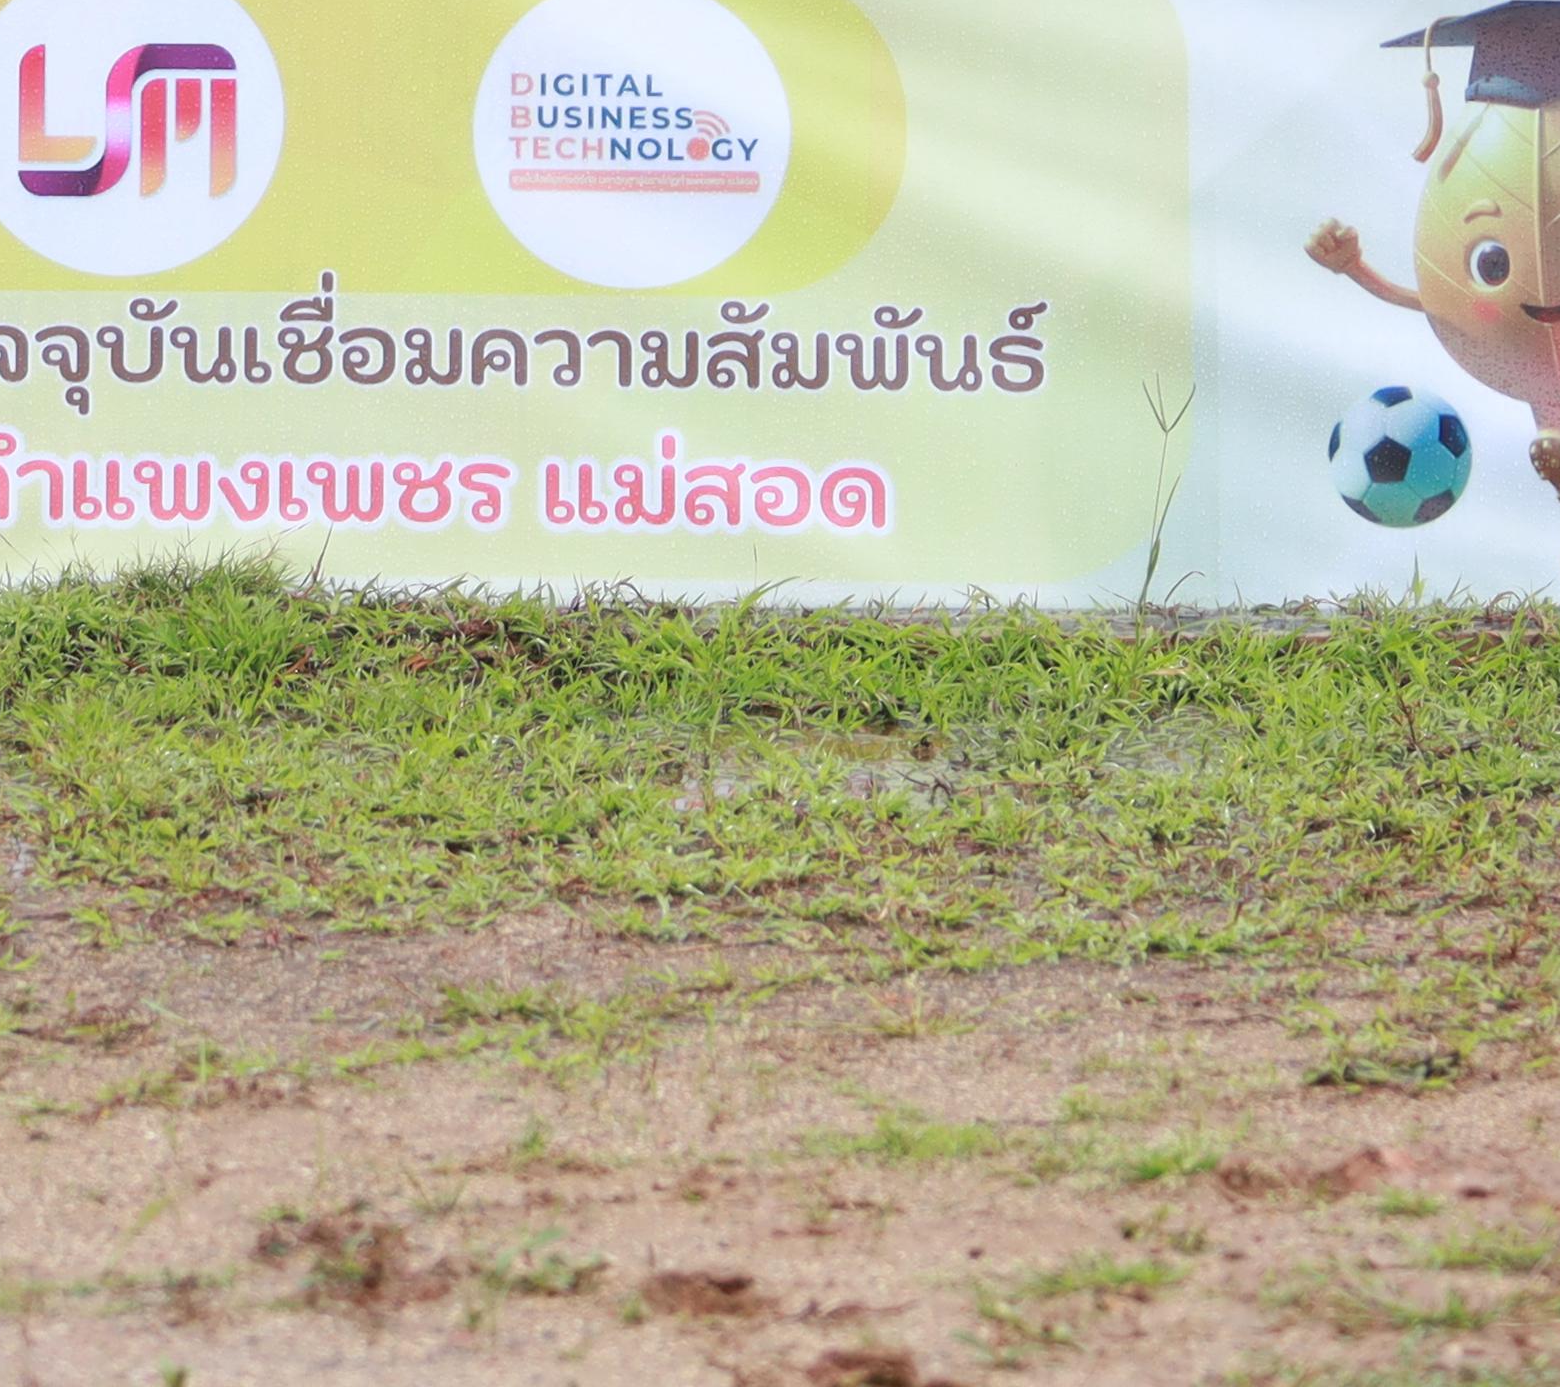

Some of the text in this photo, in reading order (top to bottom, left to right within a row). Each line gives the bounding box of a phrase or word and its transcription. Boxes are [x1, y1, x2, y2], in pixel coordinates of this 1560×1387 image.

[510, 73, 663, 97] DIGITAL
[510, 105, 694, 129] BUSINESS
[508, 136, 759, 161] TECHNOLOGY
[544, 435, 887, 529] แม่สอด
